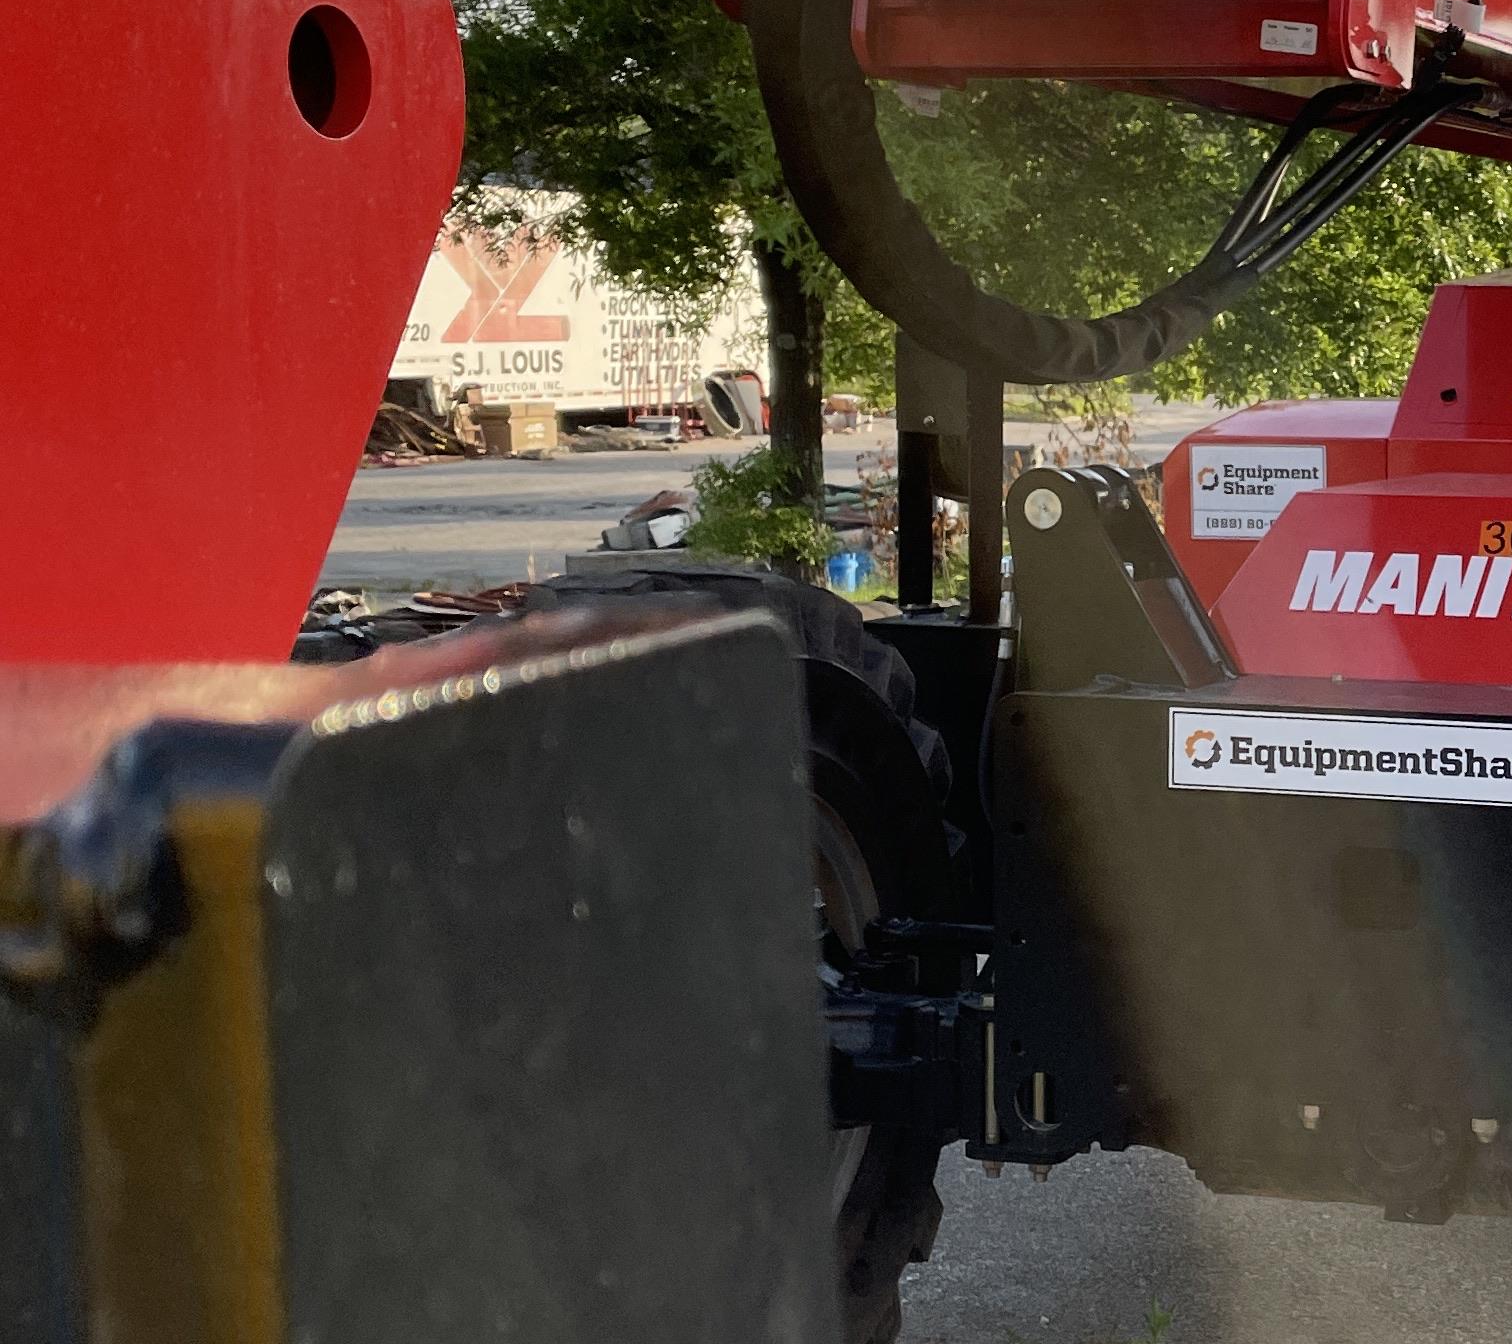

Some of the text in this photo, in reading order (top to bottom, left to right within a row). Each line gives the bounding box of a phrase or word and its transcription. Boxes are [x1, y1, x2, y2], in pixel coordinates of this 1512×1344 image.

[608, 296, 649, 316] ROCK
[452, 349, 563, 376] S.J. LOUIS
[1223, 464, 1319, 481] Equipment
[1223, 482, 1275, 495] Share
[1206, 517, 1242, 529] (888)
